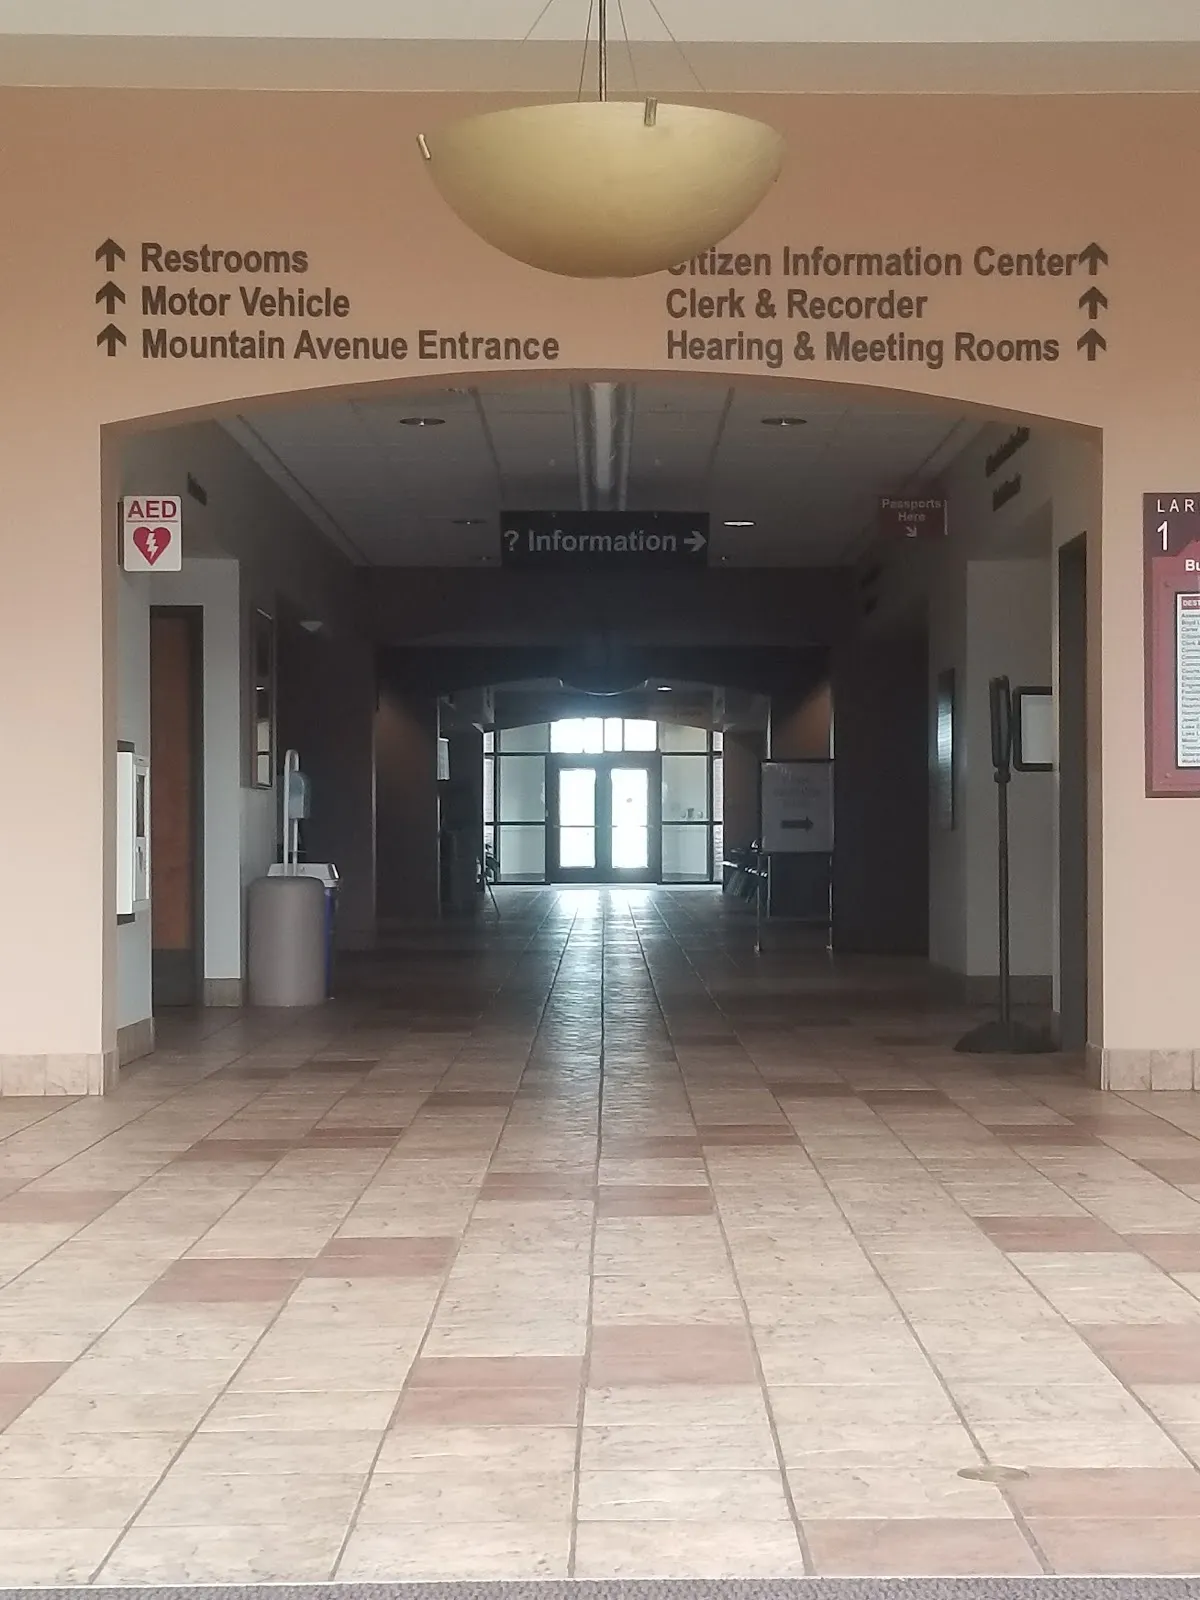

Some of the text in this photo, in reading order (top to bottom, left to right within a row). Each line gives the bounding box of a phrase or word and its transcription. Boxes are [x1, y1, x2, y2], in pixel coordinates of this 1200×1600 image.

[141, 242, 309, 273] Restrooms
[783, 245, 963, 277] Information
[973, 246, 1079, 276] Center
[141, 285, 350, 318] Motor Vehicle
[666, 287, 929, 320] Clerk & Recorder
[142, 328, 560, 361] Mountain Avenue Entrance
[667, 329, 1060, 370] Hearing & Meeting Rooms
[127, 500, 177, 519] AED
[881, 497, 942, 511] Passports
[897, 511, 926, 522] Here
[527, 529, 678, 552] Information
[1157, 520, 1168, 551] 1
